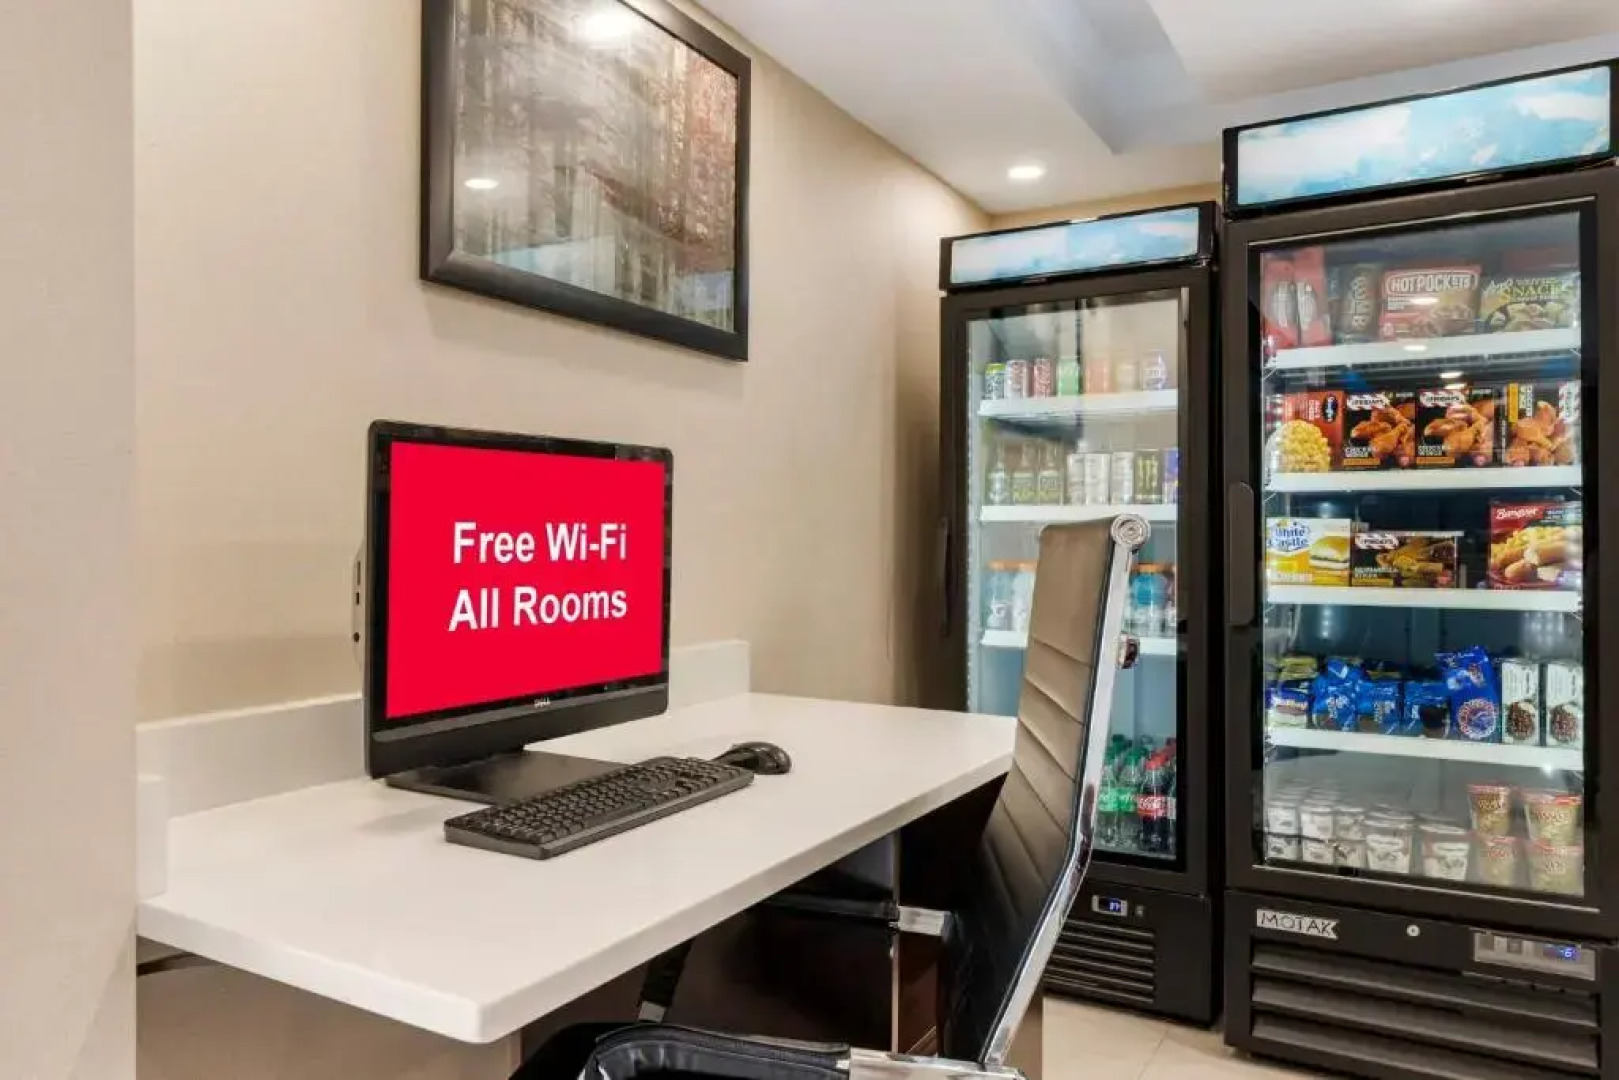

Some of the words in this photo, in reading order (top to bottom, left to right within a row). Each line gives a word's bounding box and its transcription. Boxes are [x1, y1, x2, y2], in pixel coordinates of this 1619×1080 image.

[453, 521, 535, 564] Free
[546, 522, 627, 562] Wi-Fi
[448, 587, 499, 632] All
[513, 586, 627, 625] Rooms
[1260, 911, 1334, 936] MOTAK
